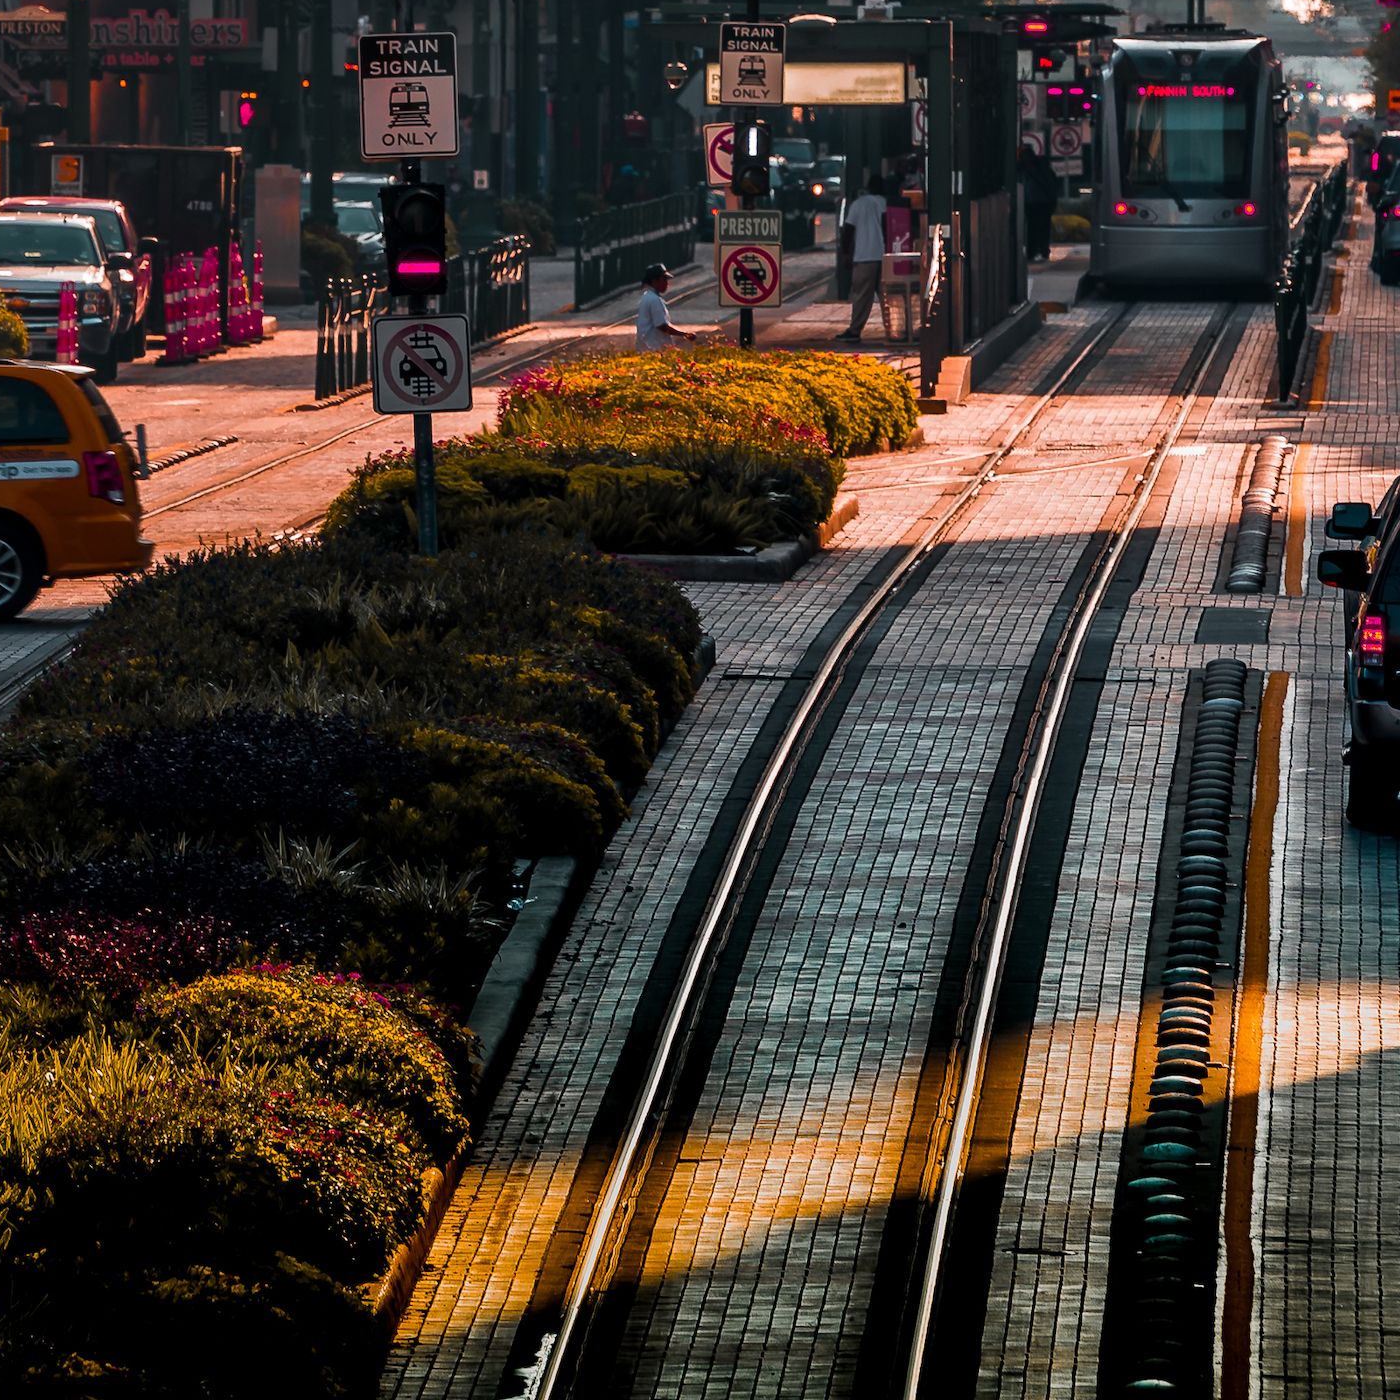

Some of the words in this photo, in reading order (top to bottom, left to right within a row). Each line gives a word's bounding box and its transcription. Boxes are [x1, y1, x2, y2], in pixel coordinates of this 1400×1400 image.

[0, 21, 62, 35] PRESTON
[92, 14, 242, 45] nshiers
[732, 26, 775, 38] TRAIN
[376, 39, 438, 55] TRAIN
[727, 39, 779, 52] SIGNAL
[120, 53, 159, 66] table
[189, 55, 206, 66] ar
[369, 59, 447, 76] SIGNAL
[732, 88, 771, 99] ONLY
[1147, 85, 1187, 97] FANNIN
[1192, 85, 1226, 97] SOUTH
[382, 132, 438, 147] ONLY
[720, 216, 779, 237] PRESTON
